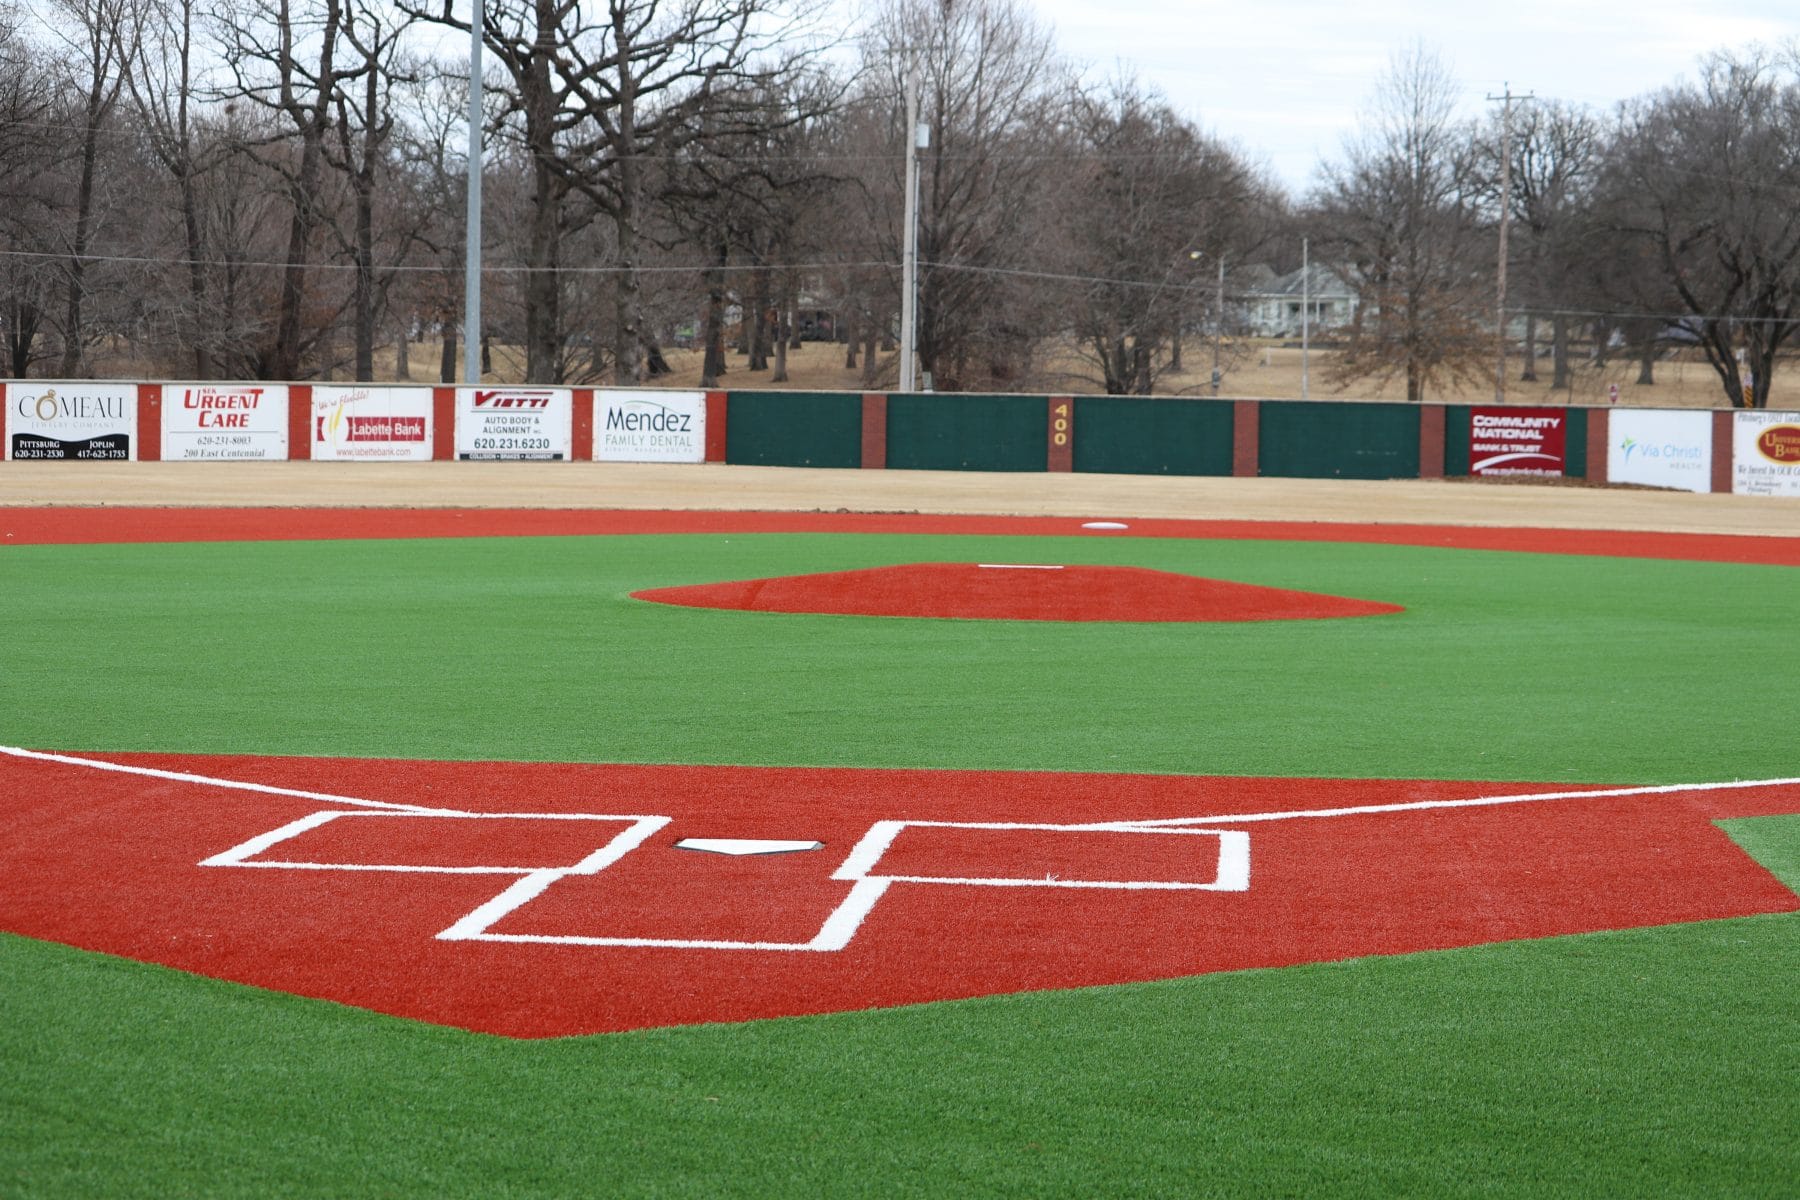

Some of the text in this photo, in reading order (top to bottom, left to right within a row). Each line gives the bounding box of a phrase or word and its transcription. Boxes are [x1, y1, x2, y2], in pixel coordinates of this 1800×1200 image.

[184, 388, 265, 409] URGENT
[18, 390, 123, 421] COMEAU
[198, 410, 250, 428] CARE
[485, 416, 540, 425] AUTO BODY &
[606, 406, 692, 432] Mendez
[1054, 404, 1067, 446] 400
[1473, 415, 1561, 429] COMMUNITY
[353, 422, 422, 436] Labette Bank
[483, 426, 532, 434] ALIGNMENT
[1473, 427, 1544, 440] NATIONAL
[19, 440, 61, 449] PITTSBURG
[89, 440, 115, 450] JOPLIN
[474, 438, 550, 449] 620.231.6230
[606, 434, 693, 447] FAMILY DENTAL
[184, 448, 265, 458] 200 East Centennial
[1472, 443, 1500, 452] BANK
[1510, 444, 1542, 453] TRUST
[1640, 444, 1702, 458] Via Christi
